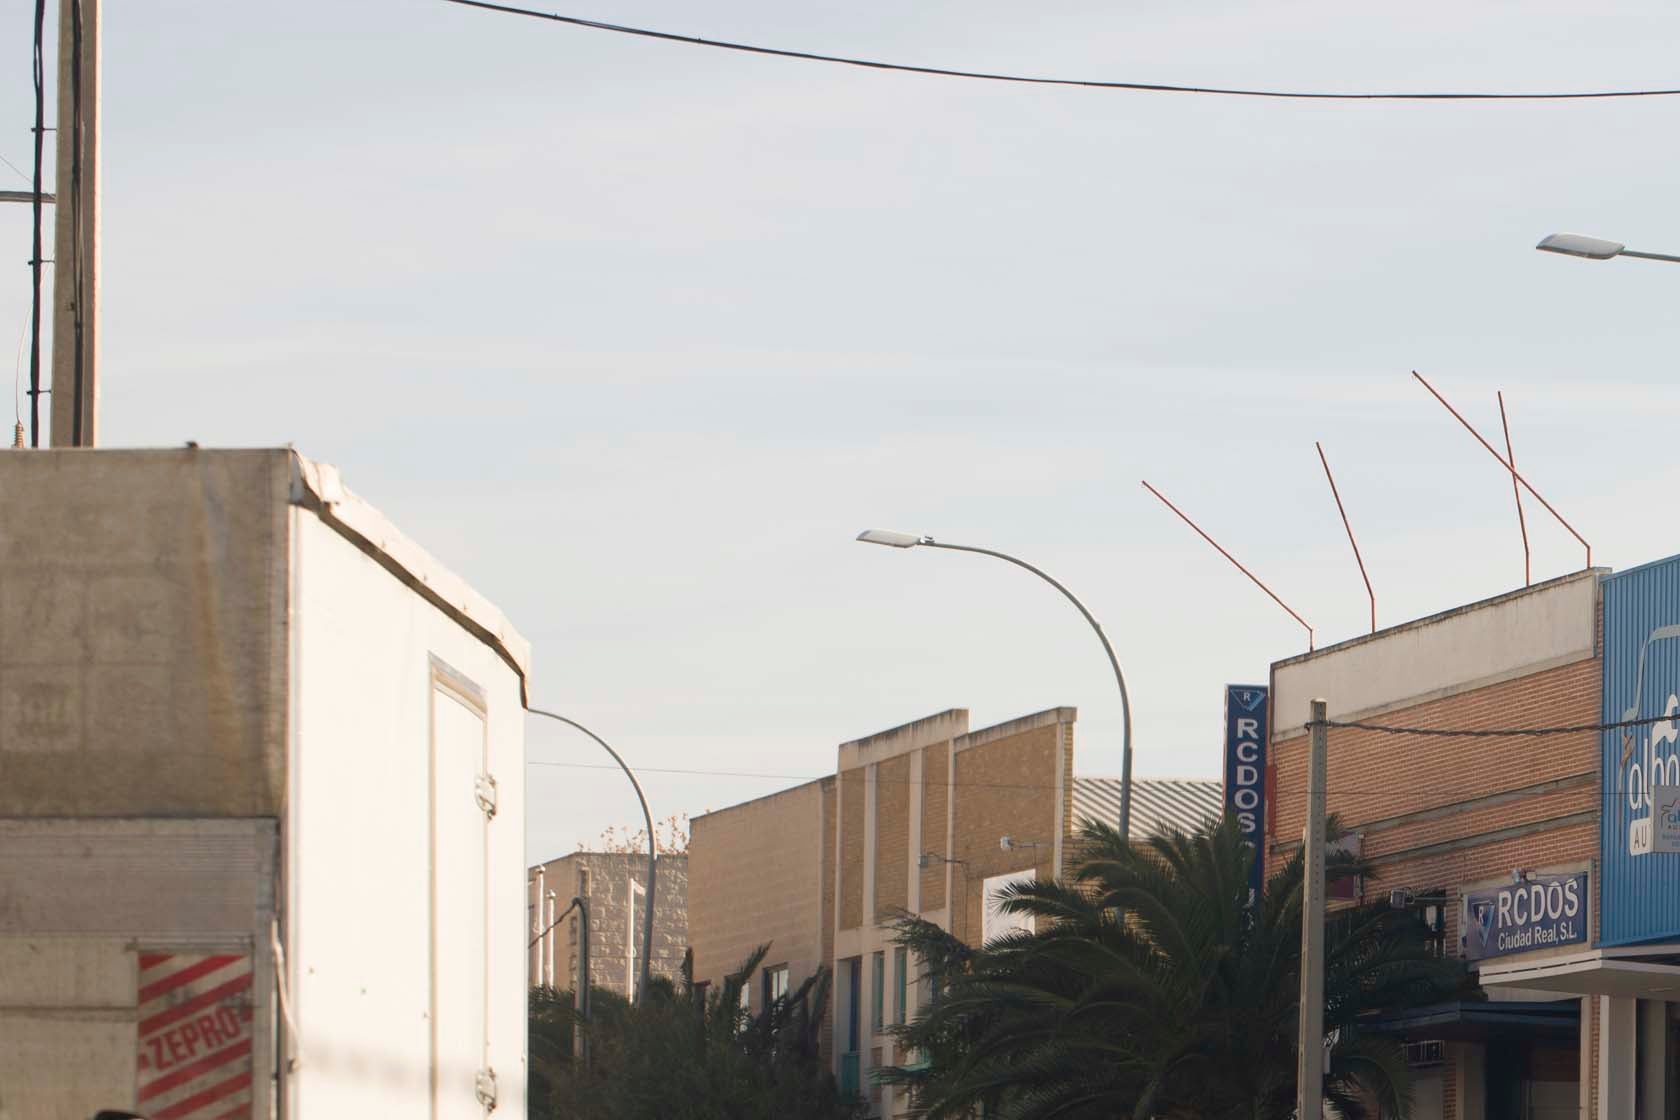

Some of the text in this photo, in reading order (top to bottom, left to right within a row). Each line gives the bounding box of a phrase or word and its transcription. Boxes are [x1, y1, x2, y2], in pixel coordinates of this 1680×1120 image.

[1234, 718, 1259, 833] RCDOS
[1498, 879, 1579, 928] RCDOS
[1498, 928, 1532, 951] Ciudad
[147, 1005, 241, 1071] ZEPRO
